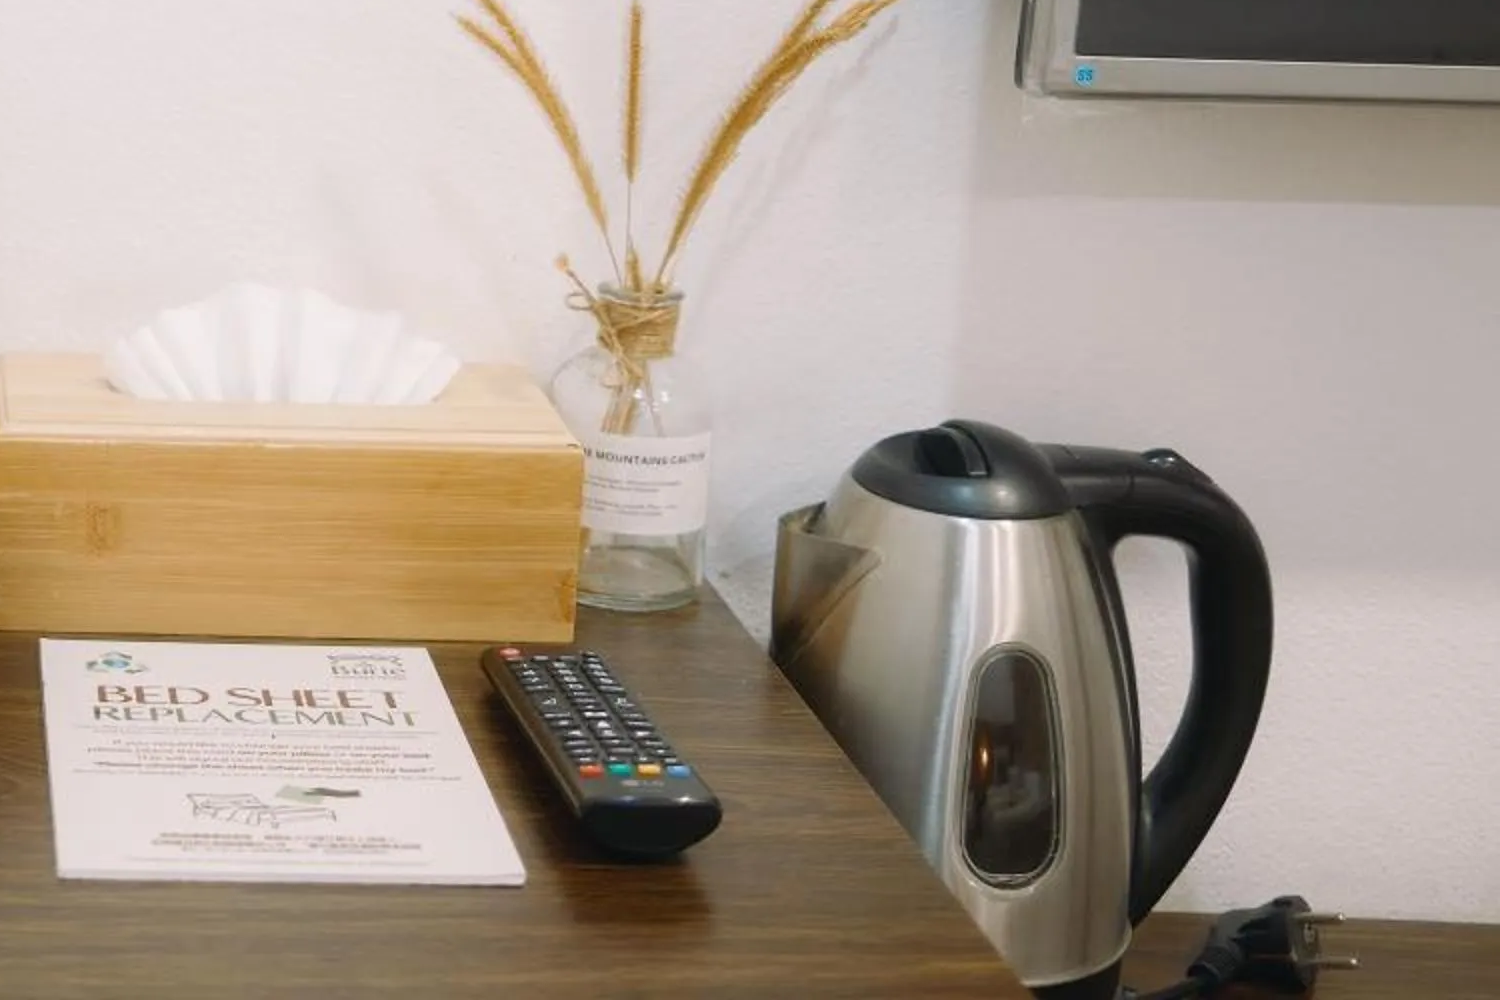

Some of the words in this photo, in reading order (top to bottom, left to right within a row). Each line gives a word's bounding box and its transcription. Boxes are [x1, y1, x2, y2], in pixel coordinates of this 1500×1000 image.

[596, 449, 669, 465] MOUNTAINS
[97, 685, 209, 705] BED
[226, 687, 405, 709] SHEET
[93, 706, 419, 728] REPLACEMENT
